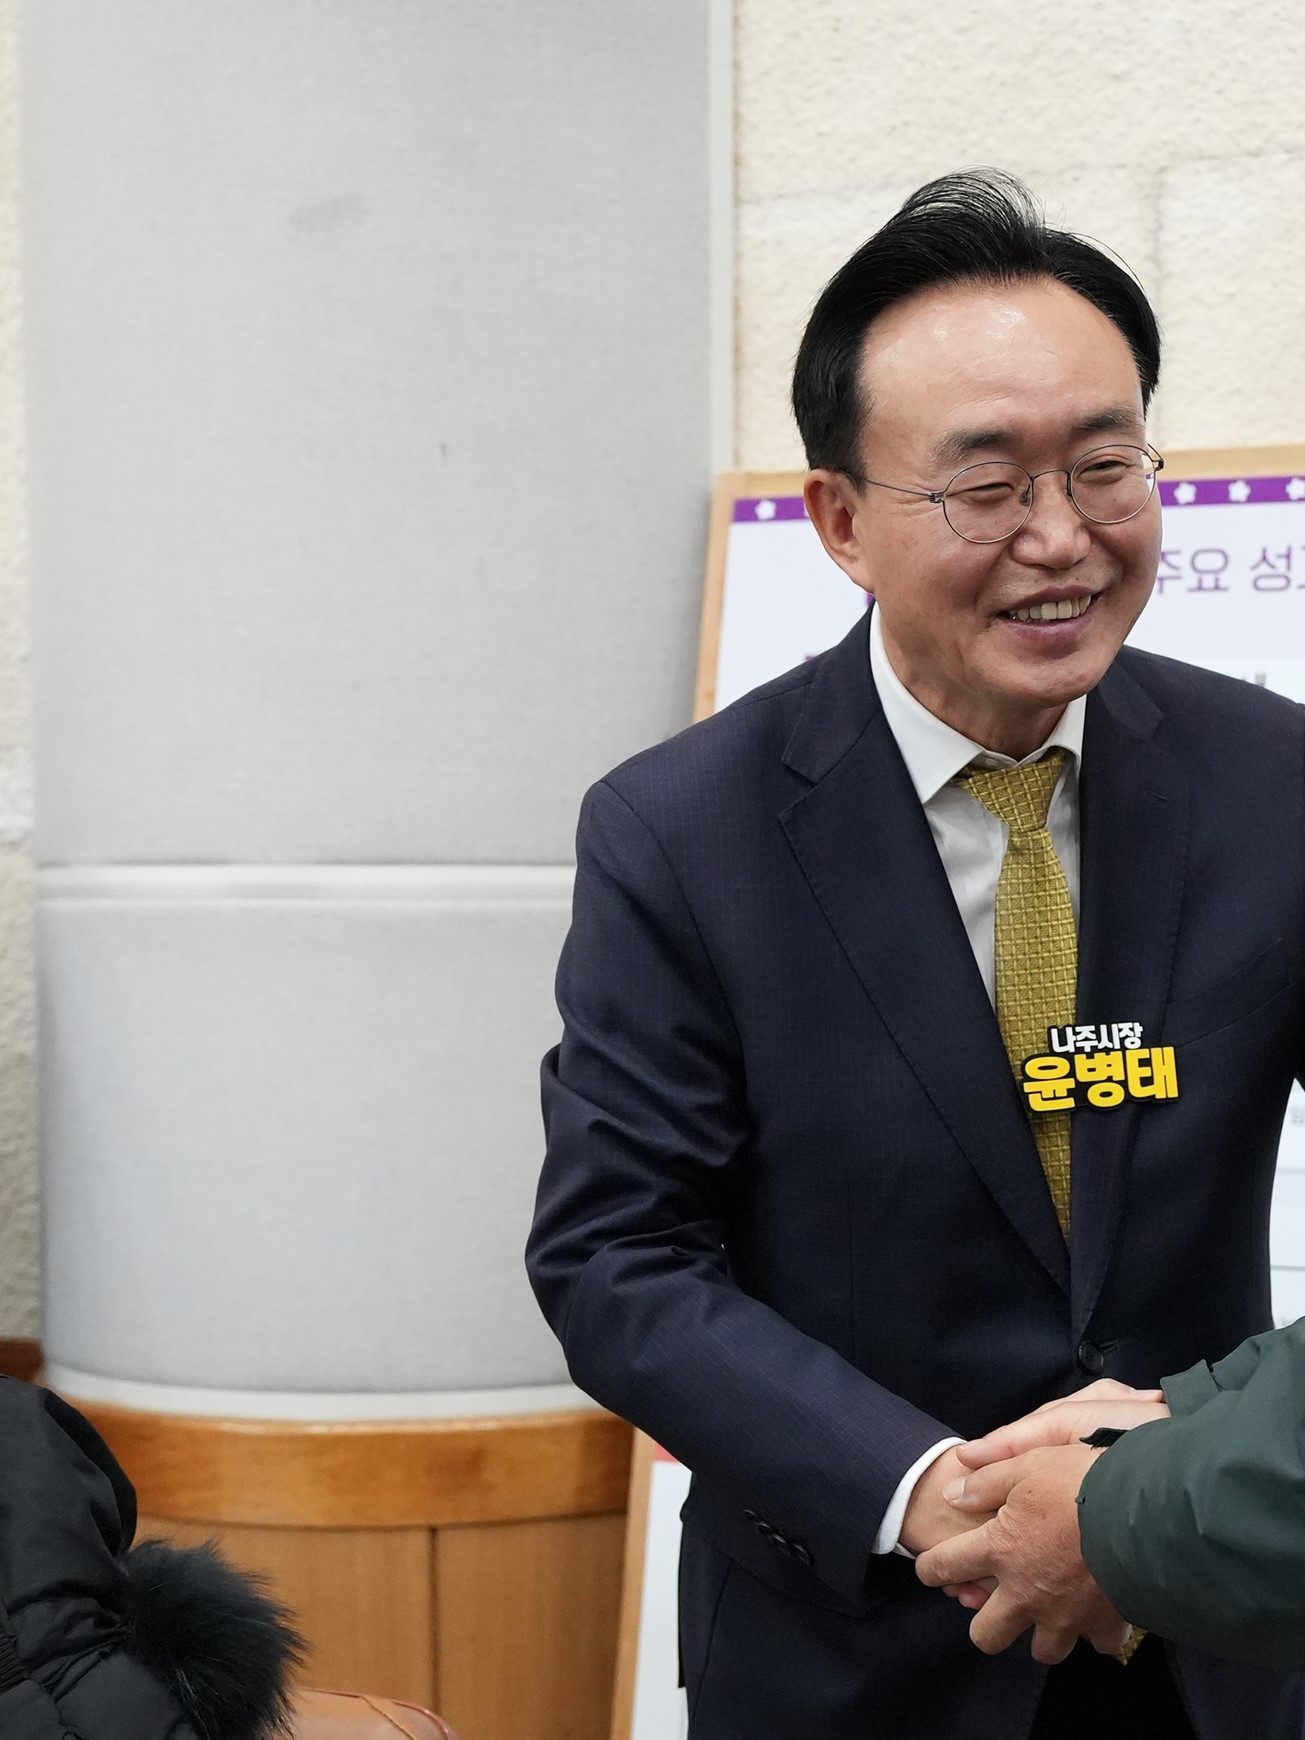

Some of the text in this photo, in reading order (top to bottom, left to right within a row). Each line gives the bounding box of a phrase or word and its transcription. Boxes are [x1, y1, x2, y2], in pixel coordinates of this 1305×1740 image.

[1157, 547, 1230, 595] 주요
[1050, 1022, 1144, 1053] 나주시장
[1023, 1046, 1179, 1112] 윤병태
